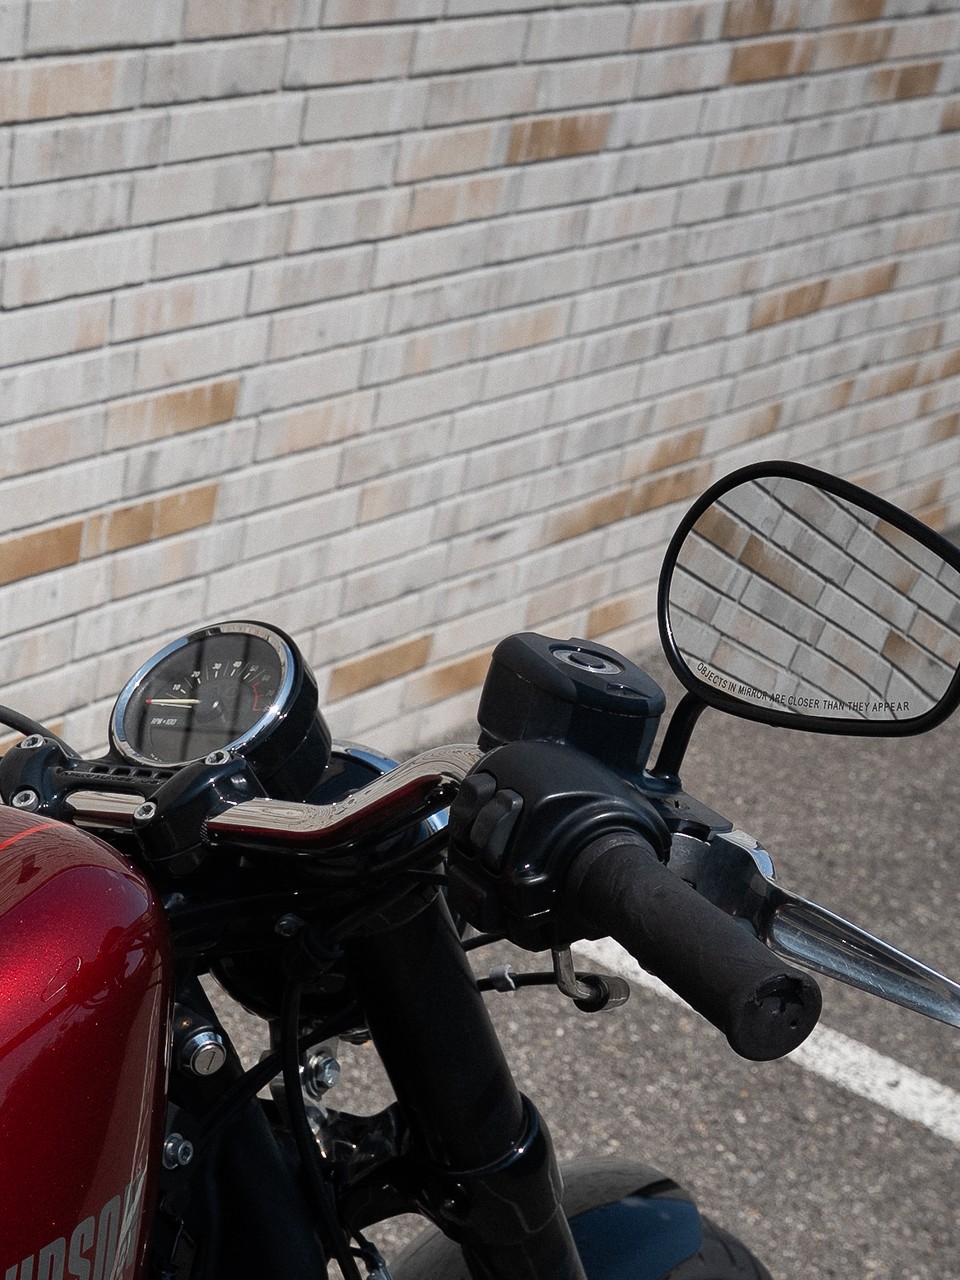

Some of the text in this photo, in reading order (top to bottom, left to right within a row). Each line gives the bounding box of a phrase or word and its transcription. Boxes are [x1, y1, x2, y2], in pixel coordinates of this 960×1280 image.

[212, 662, 222, 670] 30
[232, 660, 243, 668] 40
[191, 670, 201, 678] 20
[172, 683, 181, 691] 10
[696, 662, 910, 712] OBJECTS IN MIRROR ARE CLOSER THAN THEY APPEAR
